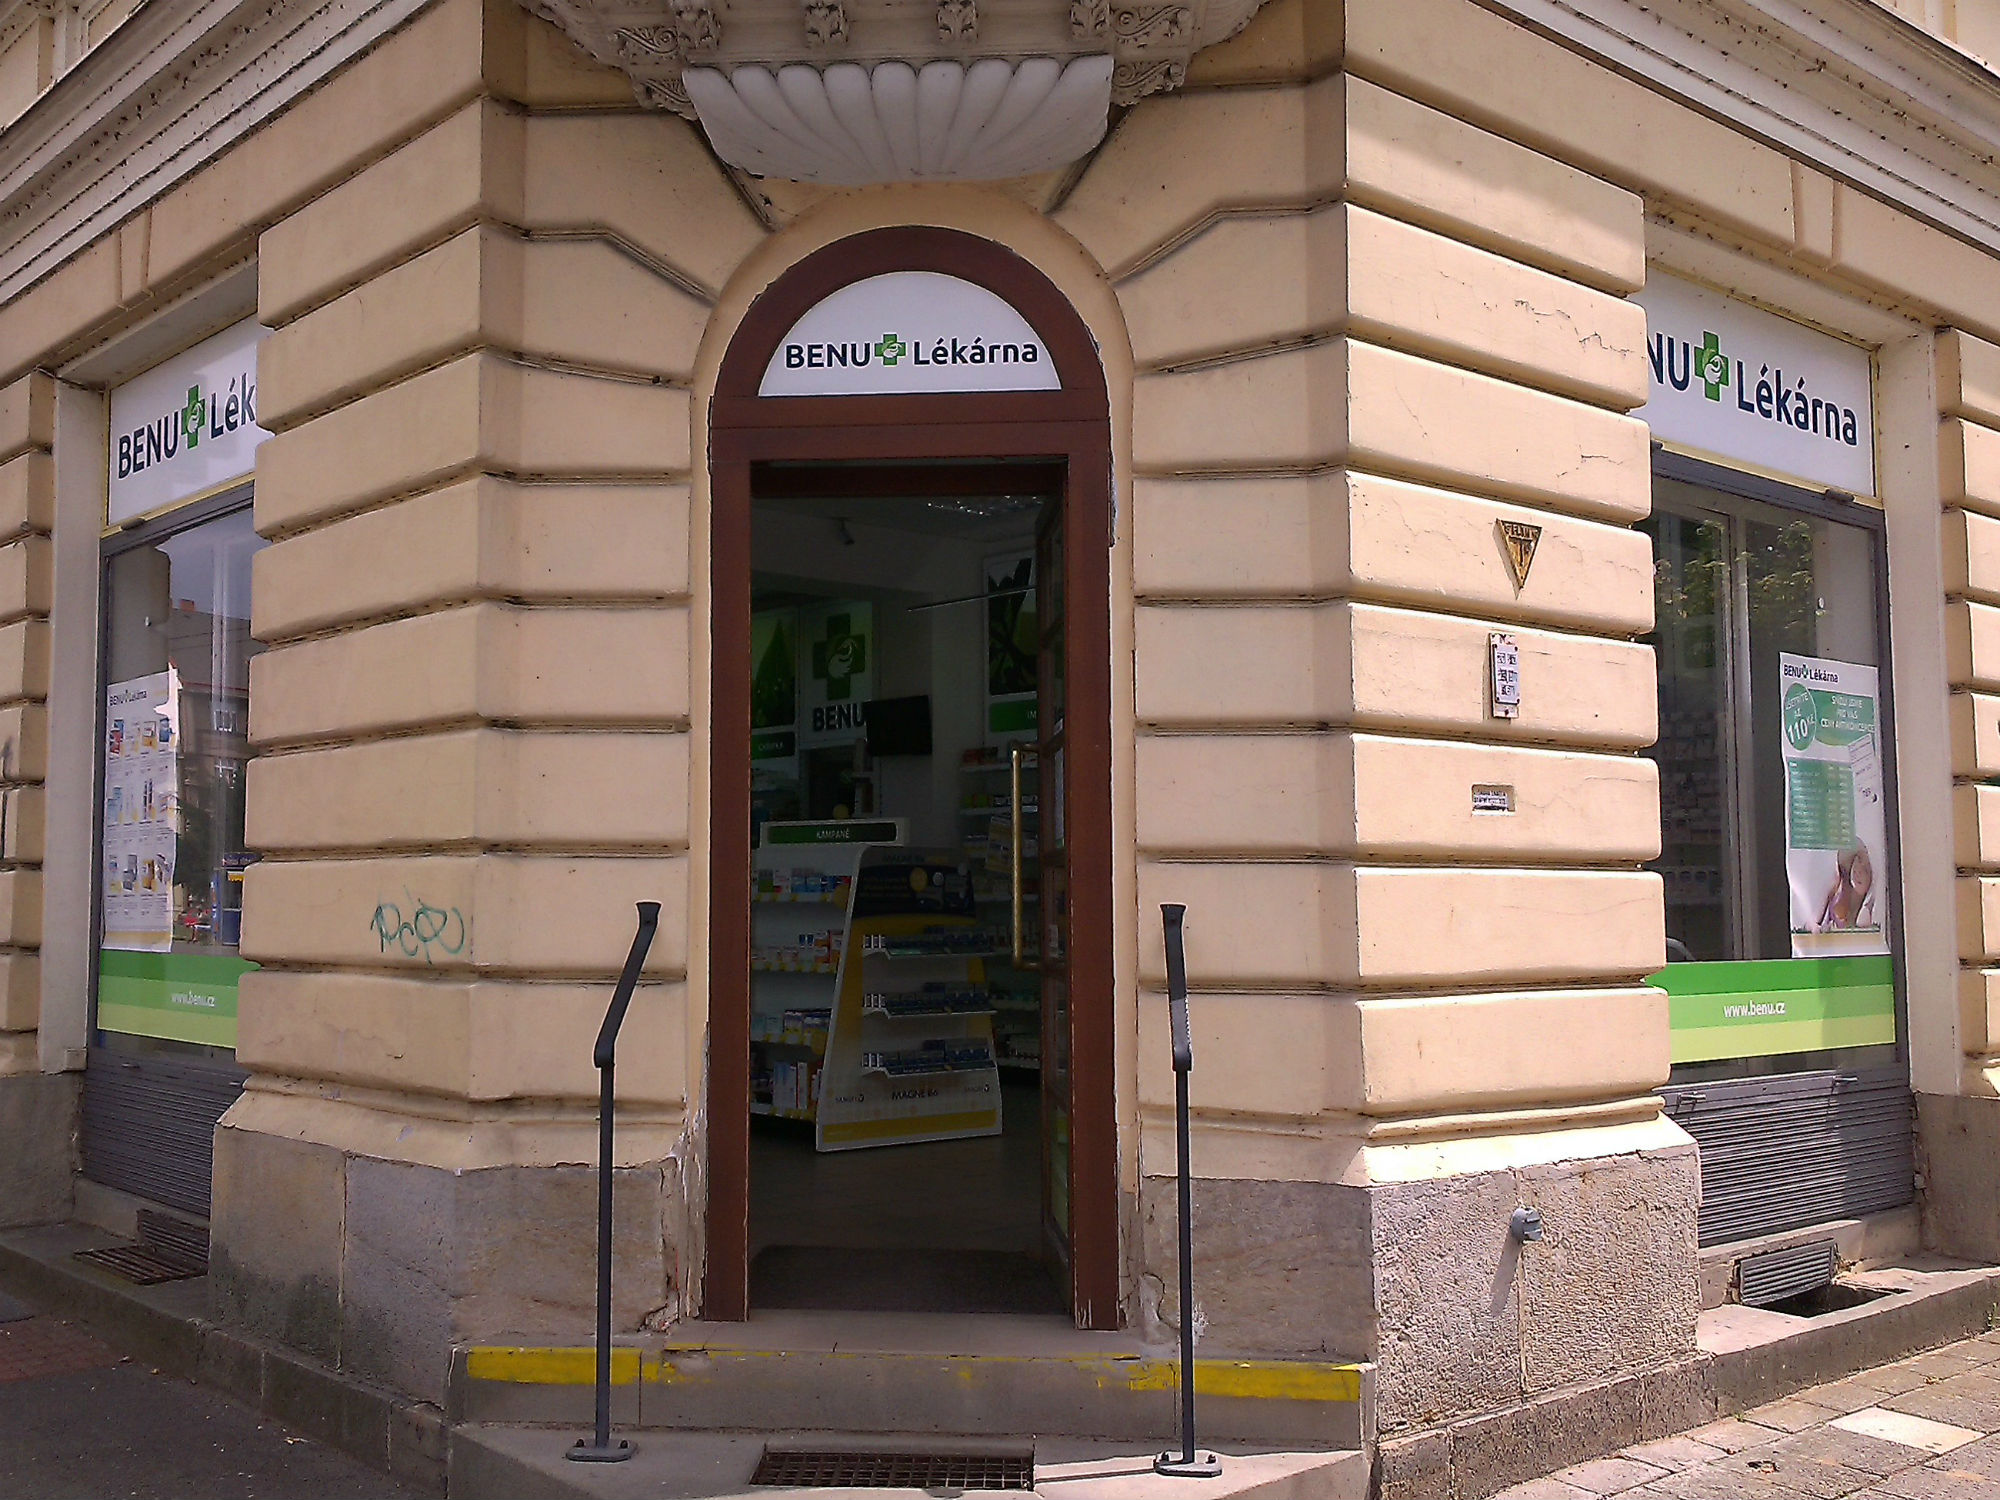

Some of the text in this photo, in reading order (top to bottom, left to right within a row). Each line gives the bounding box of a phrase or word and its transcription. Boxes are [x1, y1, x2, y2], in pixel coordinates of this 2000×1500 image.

[785, 336, 1038, 369] BENU Lékárna
[1737, 360, 1858, 446] Lékárna
[118, 411, 178, 479] BENU
[814, 702, 867, 731] BENU
[1787, 718, 1808, 744] 110
[1723, 1000, 1786, 1018] www.benu.cz
